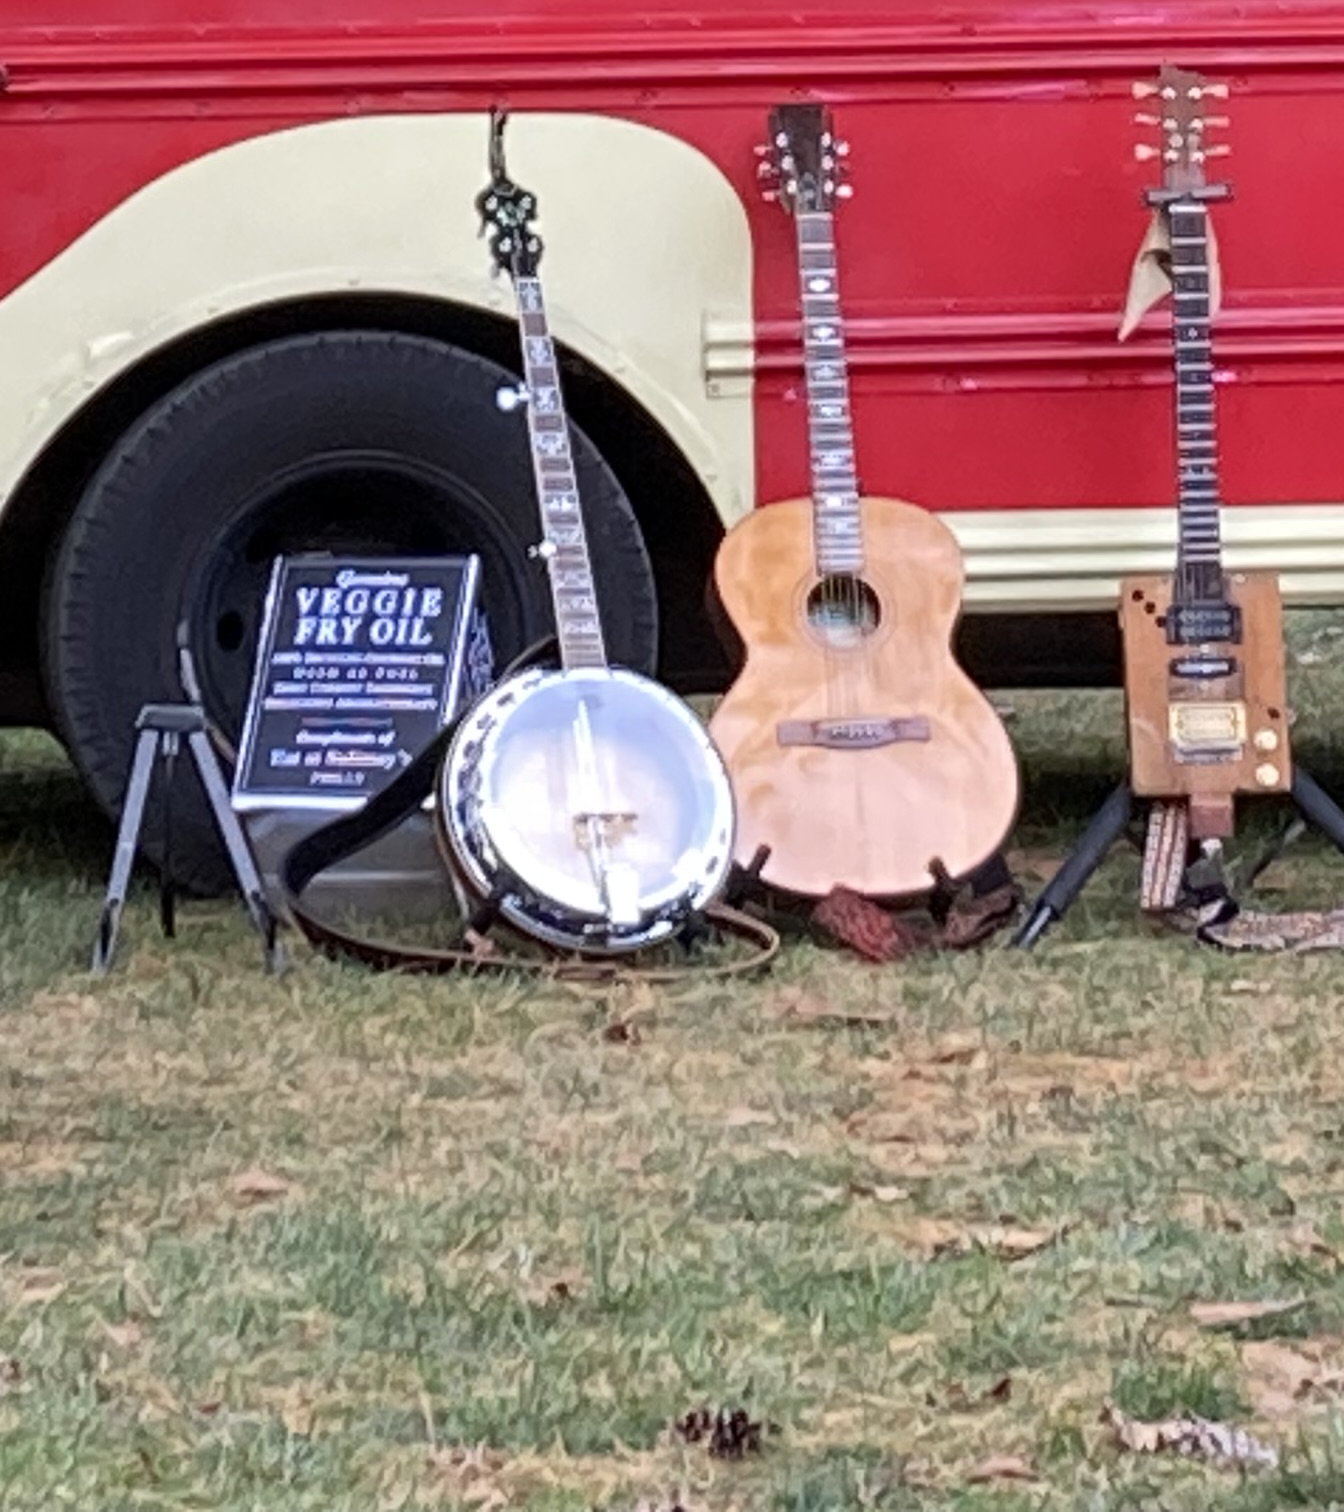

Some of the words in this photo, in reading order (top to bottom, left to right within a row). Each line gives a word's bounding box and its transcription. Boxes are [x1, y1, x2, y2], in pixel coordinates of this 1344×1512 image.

[296, 587, 443, 617] VEGGIE
[293, 616, 362, 645] FRY
[369, 617, 433, 645] OIL
